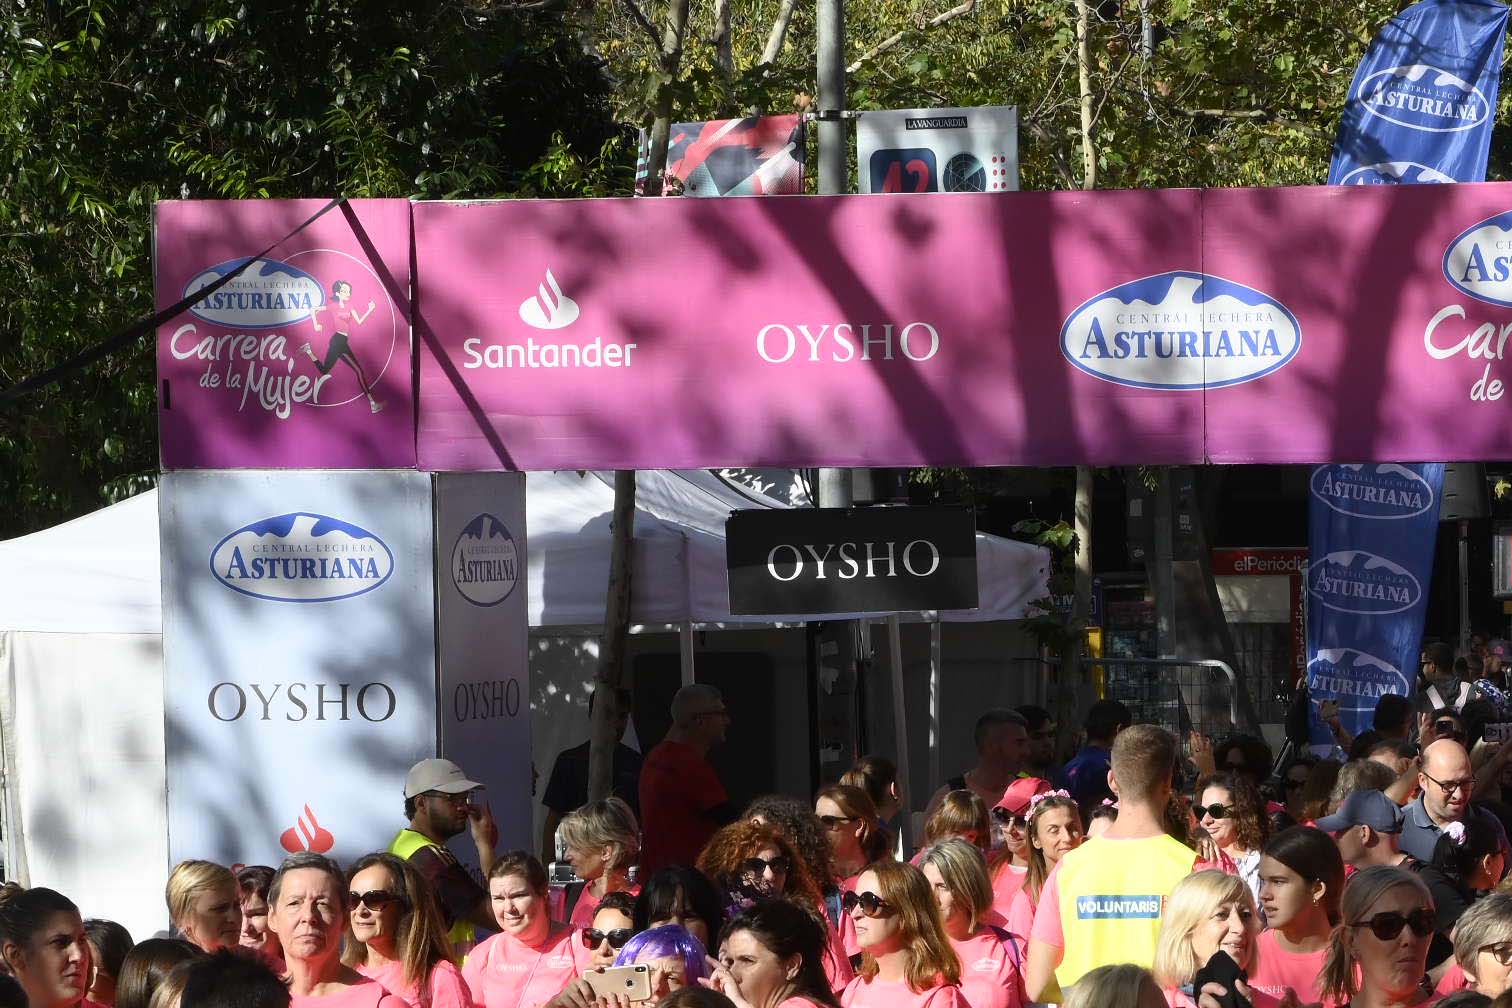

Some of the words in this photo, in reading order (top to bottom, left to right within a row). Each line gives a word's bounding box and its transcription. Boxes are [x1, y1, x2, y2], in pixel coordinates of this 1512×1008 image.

[1366, 79, 1477, 123] ASTURIANA
[218, 280, 258, 289] ENTRAL
[1116, 310, 1192, 324] CENTRAL
[1198, 309, 1275, 324] LECHERA
[170, 324, 287, 360] Carrera
[463, 337, 638, 369] Santander
[756, 322, 939, 363] OYSHO
[1080, 317, 1282, 359] ASTURIANA
[200, 363, 221, 388] de
[226, 362, 242, 388] la
[238, 357, 334, 419] Mujer
[1470, 363, 1506, 401] de
[1322, 472, 1423, 509] ASTURIANA
[226, 546, 380, 581] ASTURIANA
[252, 543, 312, 553] CENTRAL
[317, 543, 374, 553] LECHERA
[457, 547, 515, 586] ASTURIANA
[768, 539, 942, 582] OYSHO
[1234, 556, 1308, 573] elPeriódi
[1317, 567, 1411, 603] ASTURIANA
[208, 682, 397, 722] OYSHO
[454, 678, 521, 722] OYSHO
[1078, 899, 1159, 914] VOLUNTARIS
